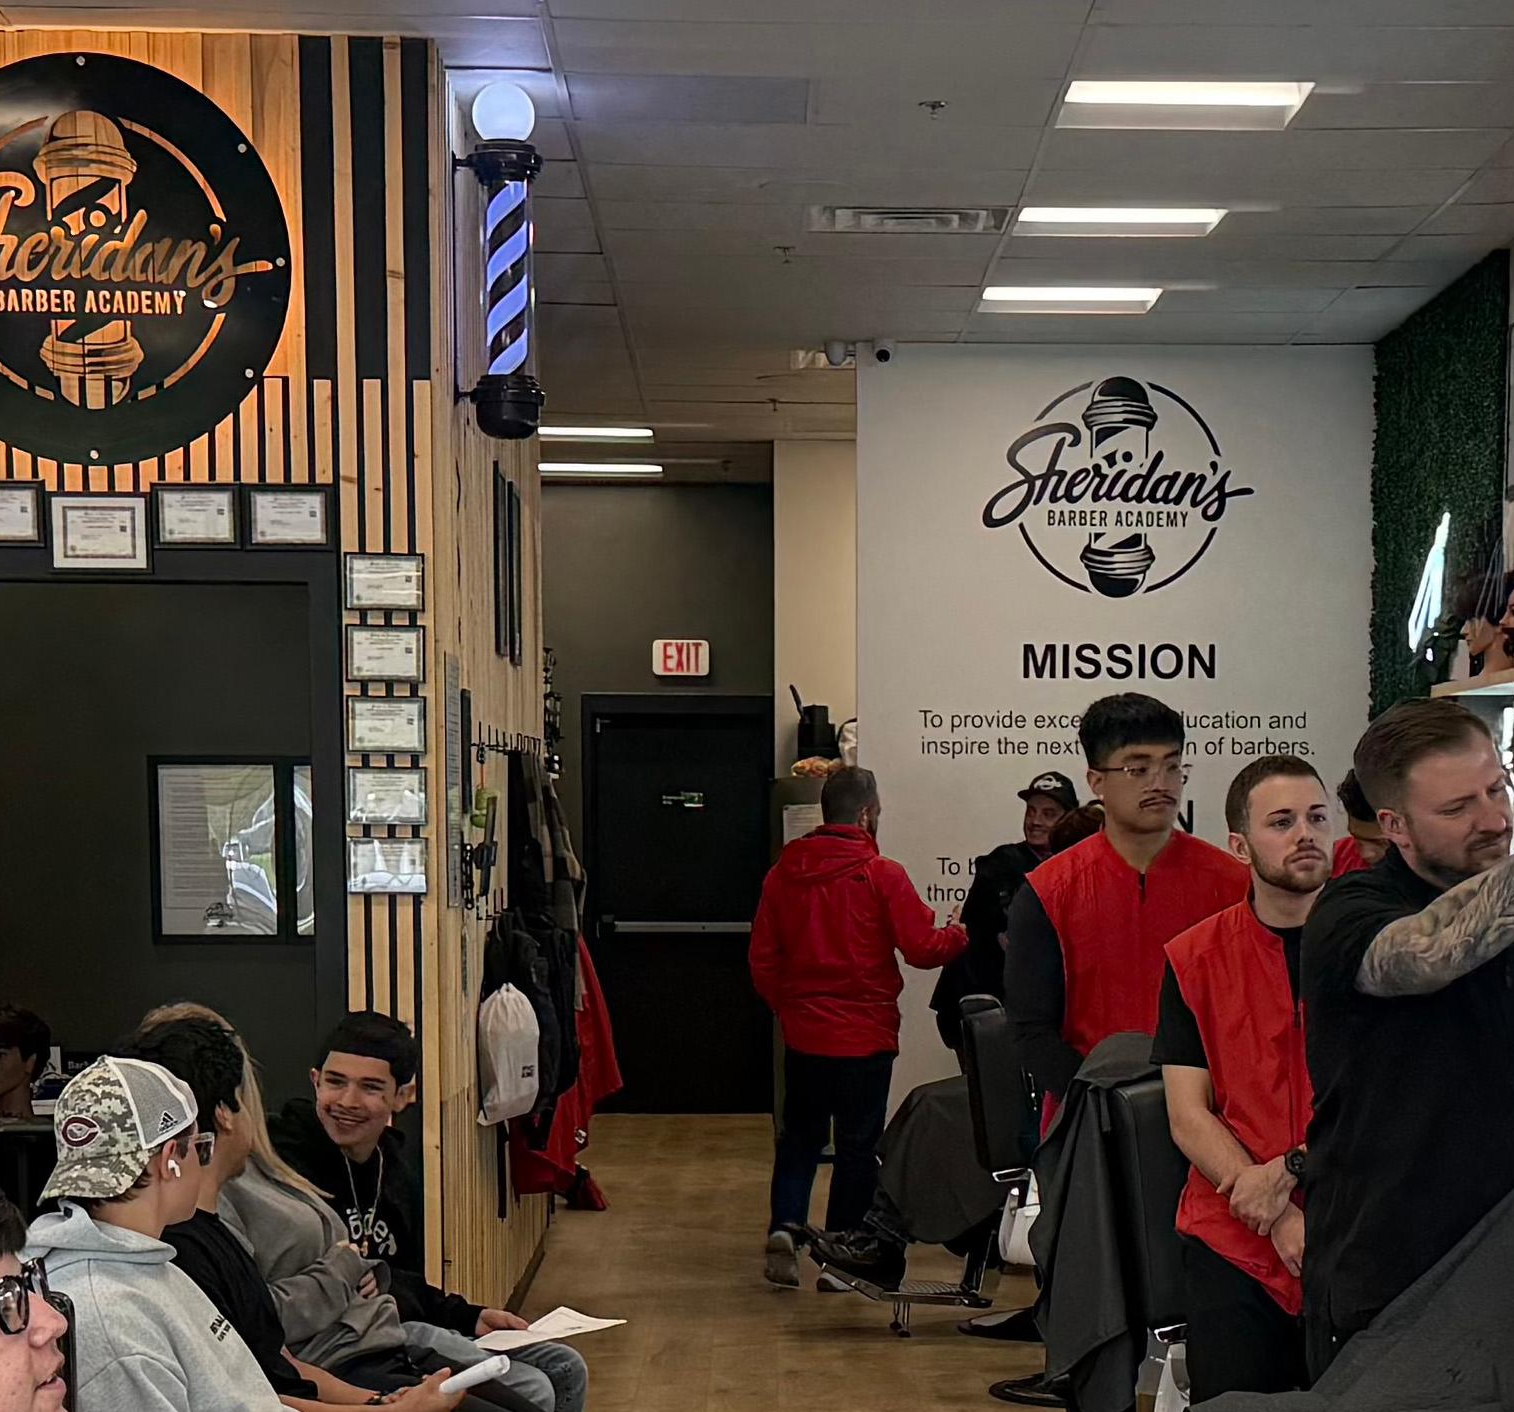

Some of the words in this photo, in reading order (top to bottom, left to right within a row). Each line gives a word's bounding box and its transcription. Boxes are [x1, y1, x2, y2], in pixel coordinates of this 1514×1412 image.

[85, 287, 187, 315] ACADEMY
[982, 421, 1254, 529] Sheridan's
[1046, 508, 1108, 528] BARBER
[1114, 508, 1189, 529] ACADEMY
[662, 642, 702, 673] EXIT
[1021, 642, 1217, 680] MISSION
[918, 709, 943, 729] To
[950, 709, 1027, 733] provide
[1268, 711, 1307, 729] and
[920, 736, 990, 759] inspire
[998, 736, 1029, 755] the
[1036, 738, 1079, 755] next
[1204, 736, 1225, 756] of
[1231, 736, 1315, 756] barbers.
[936, 856, 961, 876] To
[927, 883, 966, 902] thro
